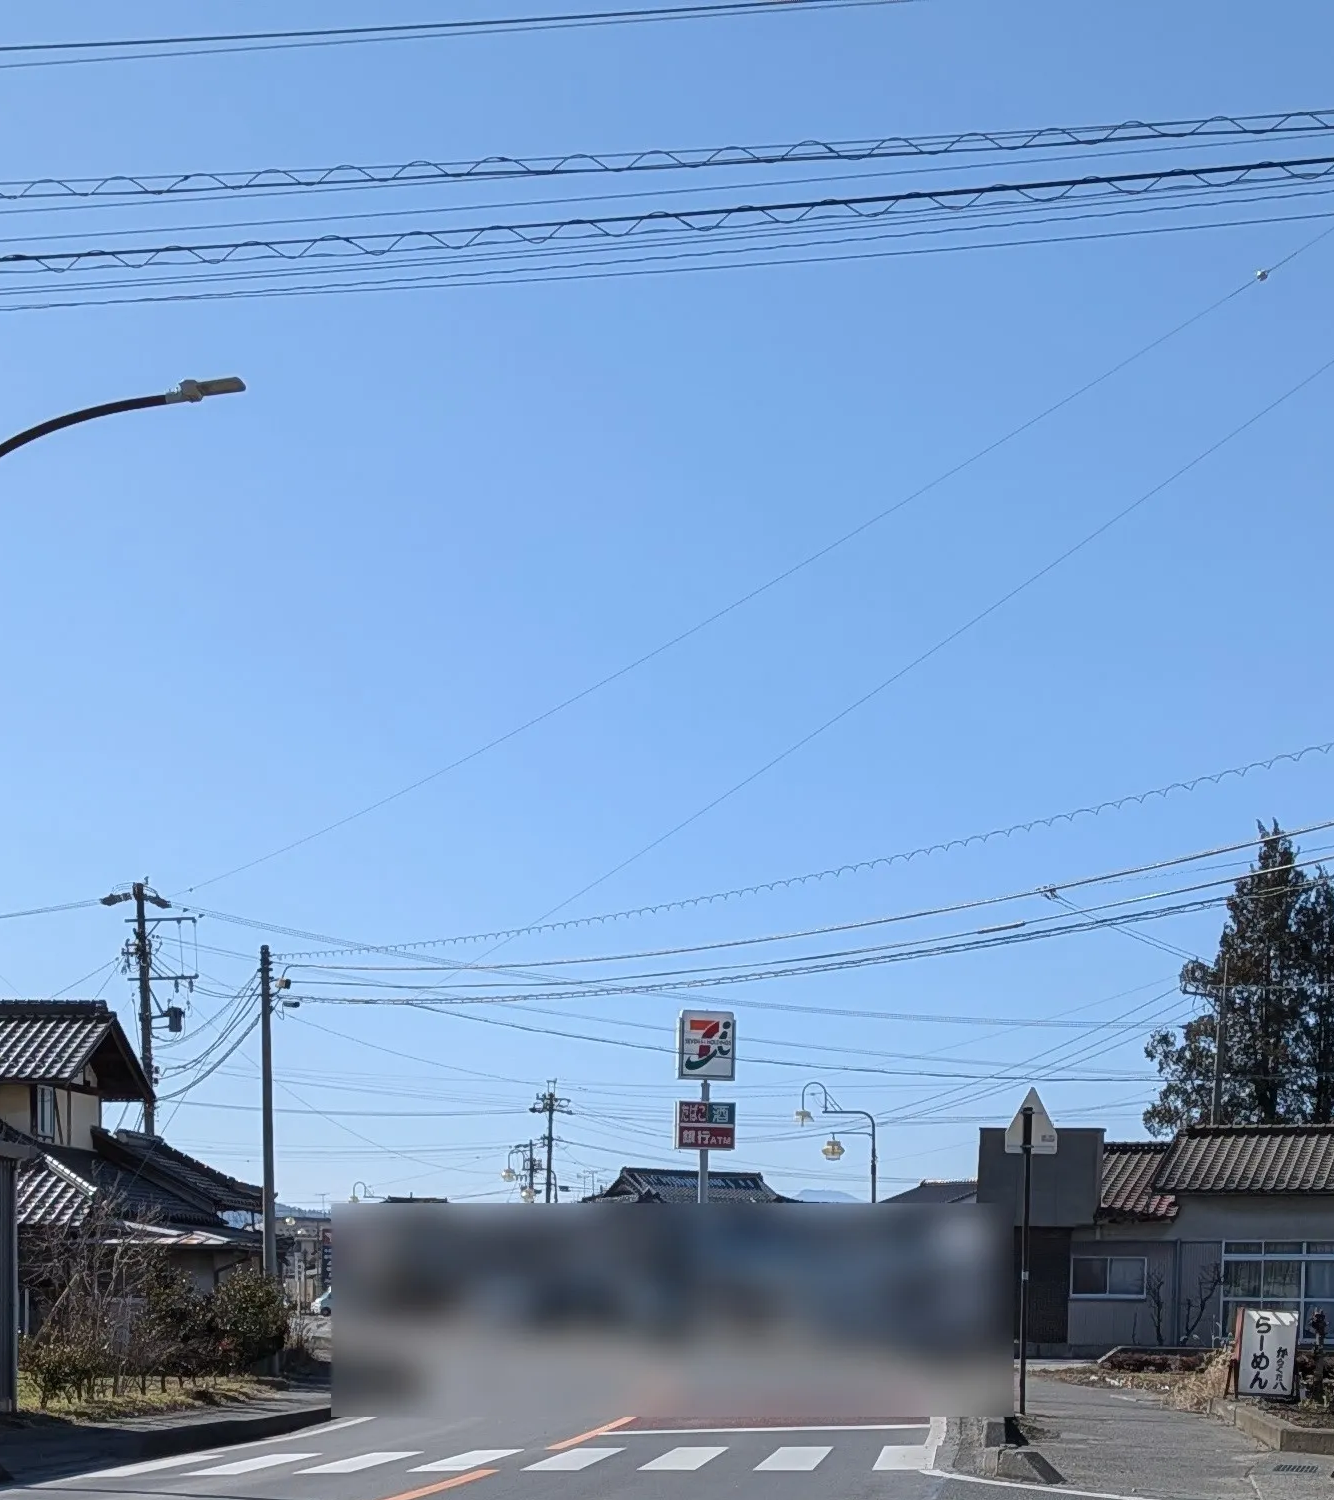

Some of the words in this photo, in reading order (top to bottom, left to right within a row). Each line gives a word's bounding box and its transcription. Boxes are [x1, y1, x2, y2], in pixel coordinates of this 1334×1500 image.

[680, 1104, 707, 1122] たばこ
[712, 1105, 730, 1123] 酒
[1249, 1315, 1272, 1391] らーめん
